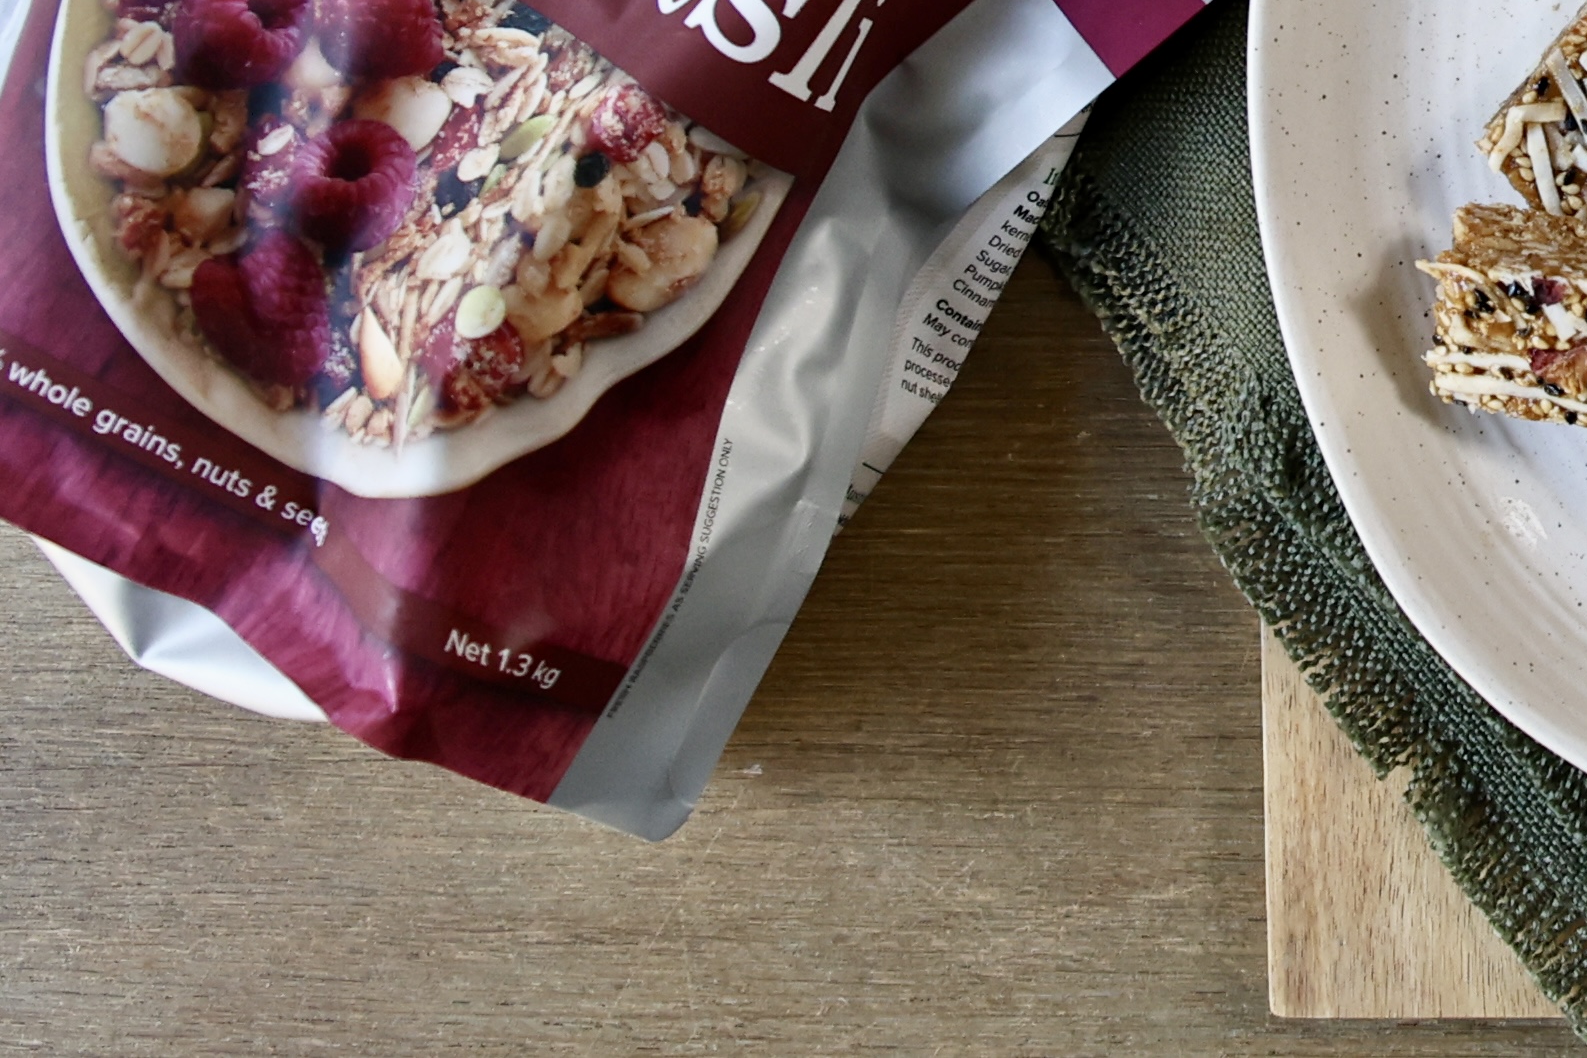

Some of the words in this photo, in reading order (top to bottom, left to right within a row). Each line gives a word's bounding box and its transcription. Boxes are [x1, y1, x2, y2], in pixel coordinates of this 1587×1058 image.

[922, 312, 952, 337] May
[911, 336, 934, 358] This
[901, 379, 918, 395] nut
[8, 360, 94, 418] whole
[92, 407, 184, 470] grains,
[191, 455, 253, 499] nuts
[255, 484, 278, 512] &
[680, 546, 707, 596] SERVING
[700, 468, 726, 545] SUGGESTION
[718, 437, 734, 468] ONLY
[443, 628, 492, 667] Net
